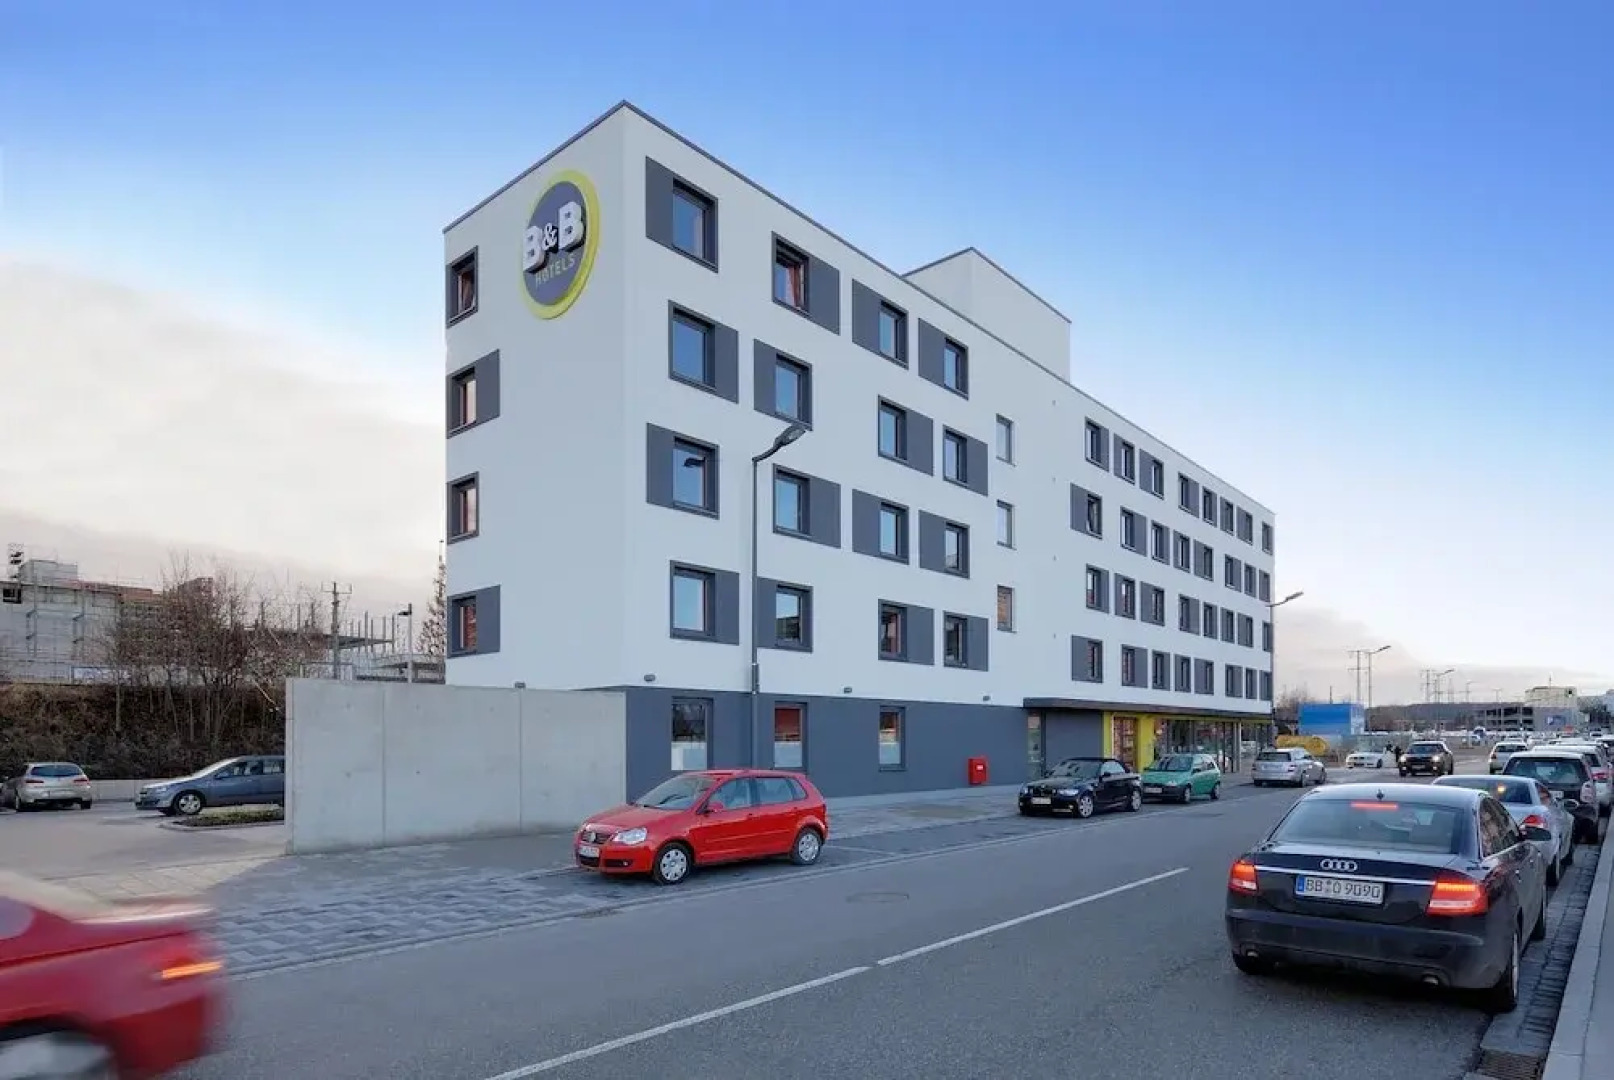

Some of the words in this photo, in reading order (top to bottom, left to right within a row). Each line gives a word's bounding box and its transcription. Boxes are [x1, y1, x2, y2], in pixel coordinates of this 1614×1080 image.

[523, 201, 586, 272] B&B
[535, 253, 576, 286] HOTELS
[1306, 879, 1323, 892] BB
[1345, 882, 1380, 898] 9090
